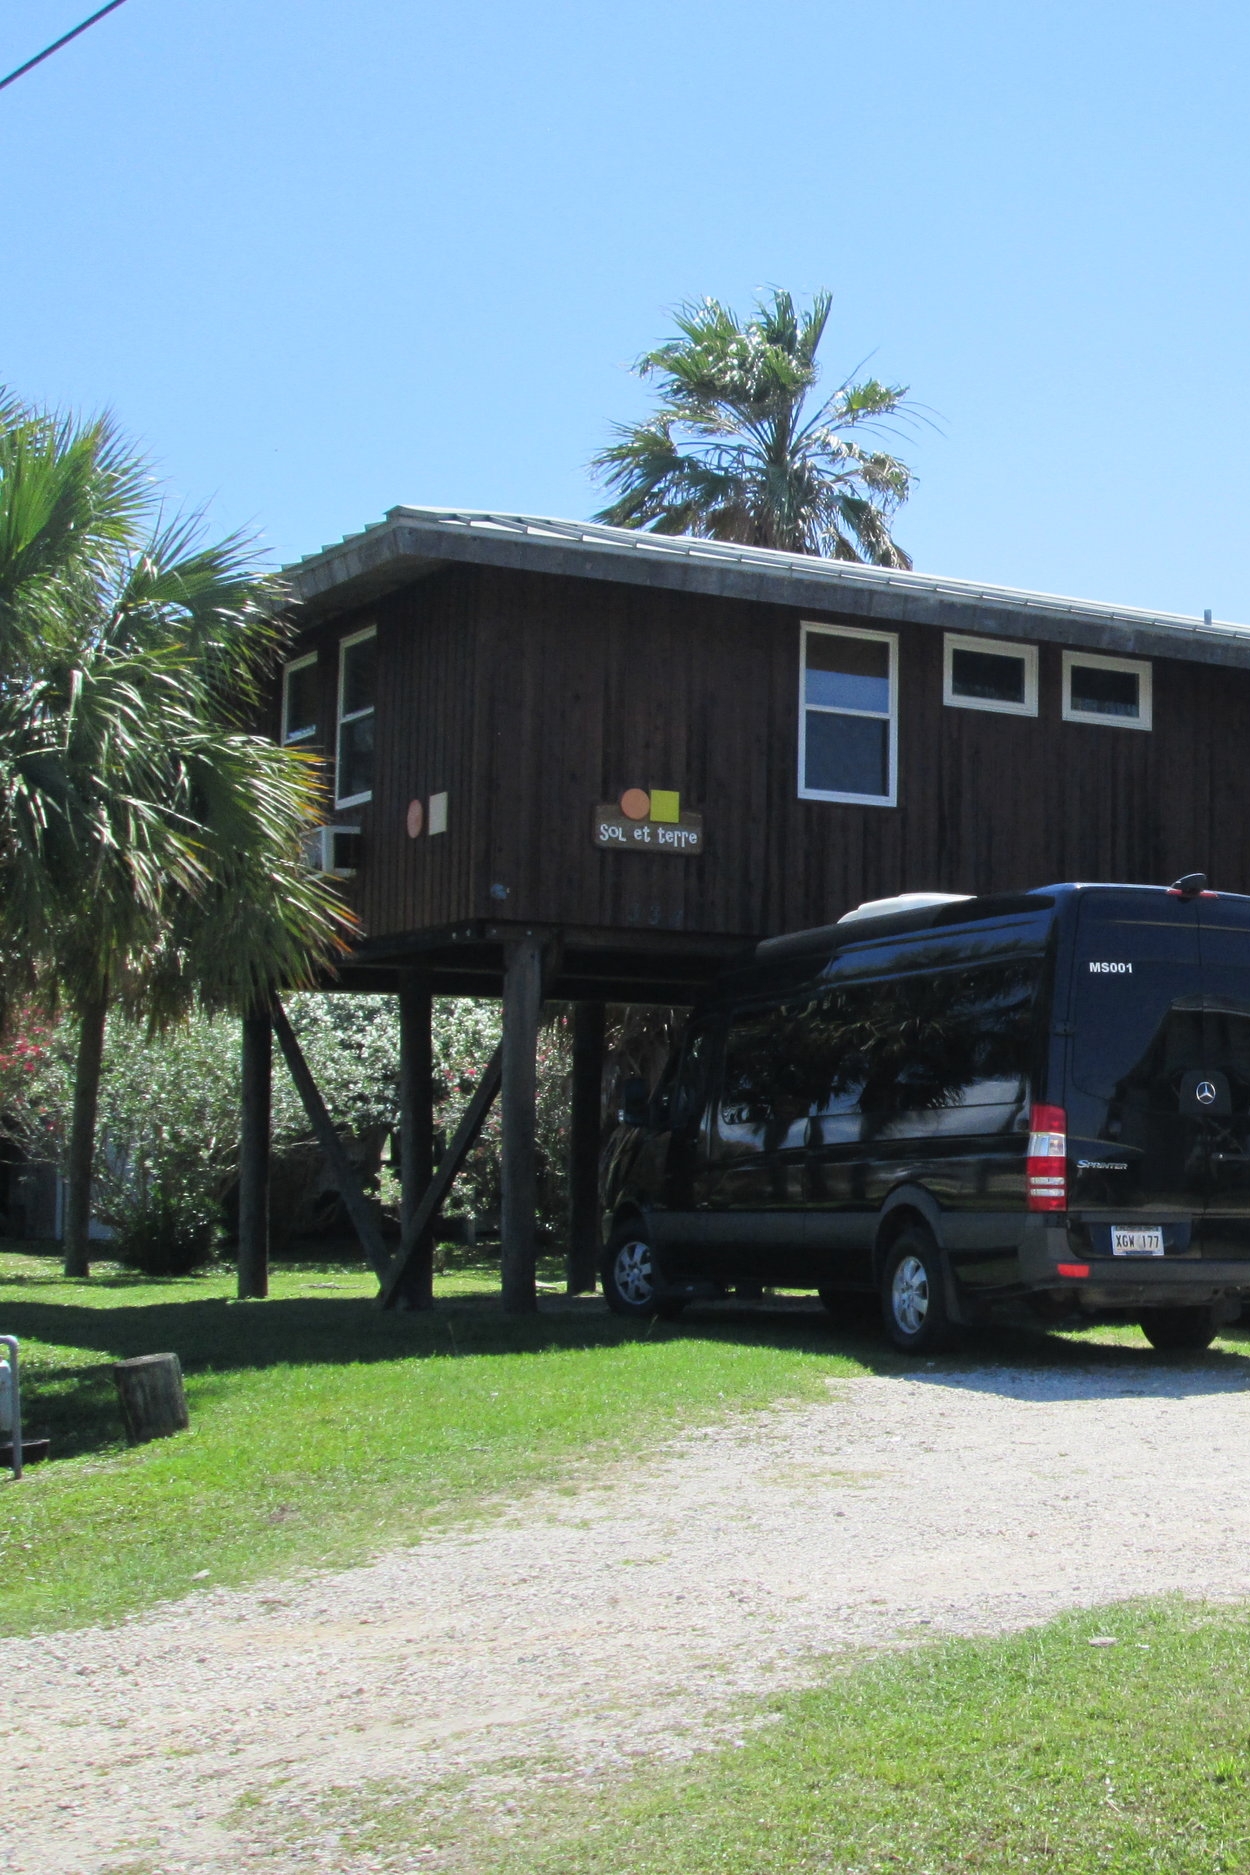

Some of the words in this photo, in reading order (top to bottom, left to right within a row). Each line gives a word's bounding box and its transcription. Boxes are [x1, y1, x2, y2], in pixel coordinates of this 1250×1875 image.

[634, 825, 651, 843] et
[657, 827, 698, 847] terre
[1089, 962, 1133, 974] MS001
[1115, 1234, 1135, 1248] XGW
[1141, 1235, 1160, 1249] 177
